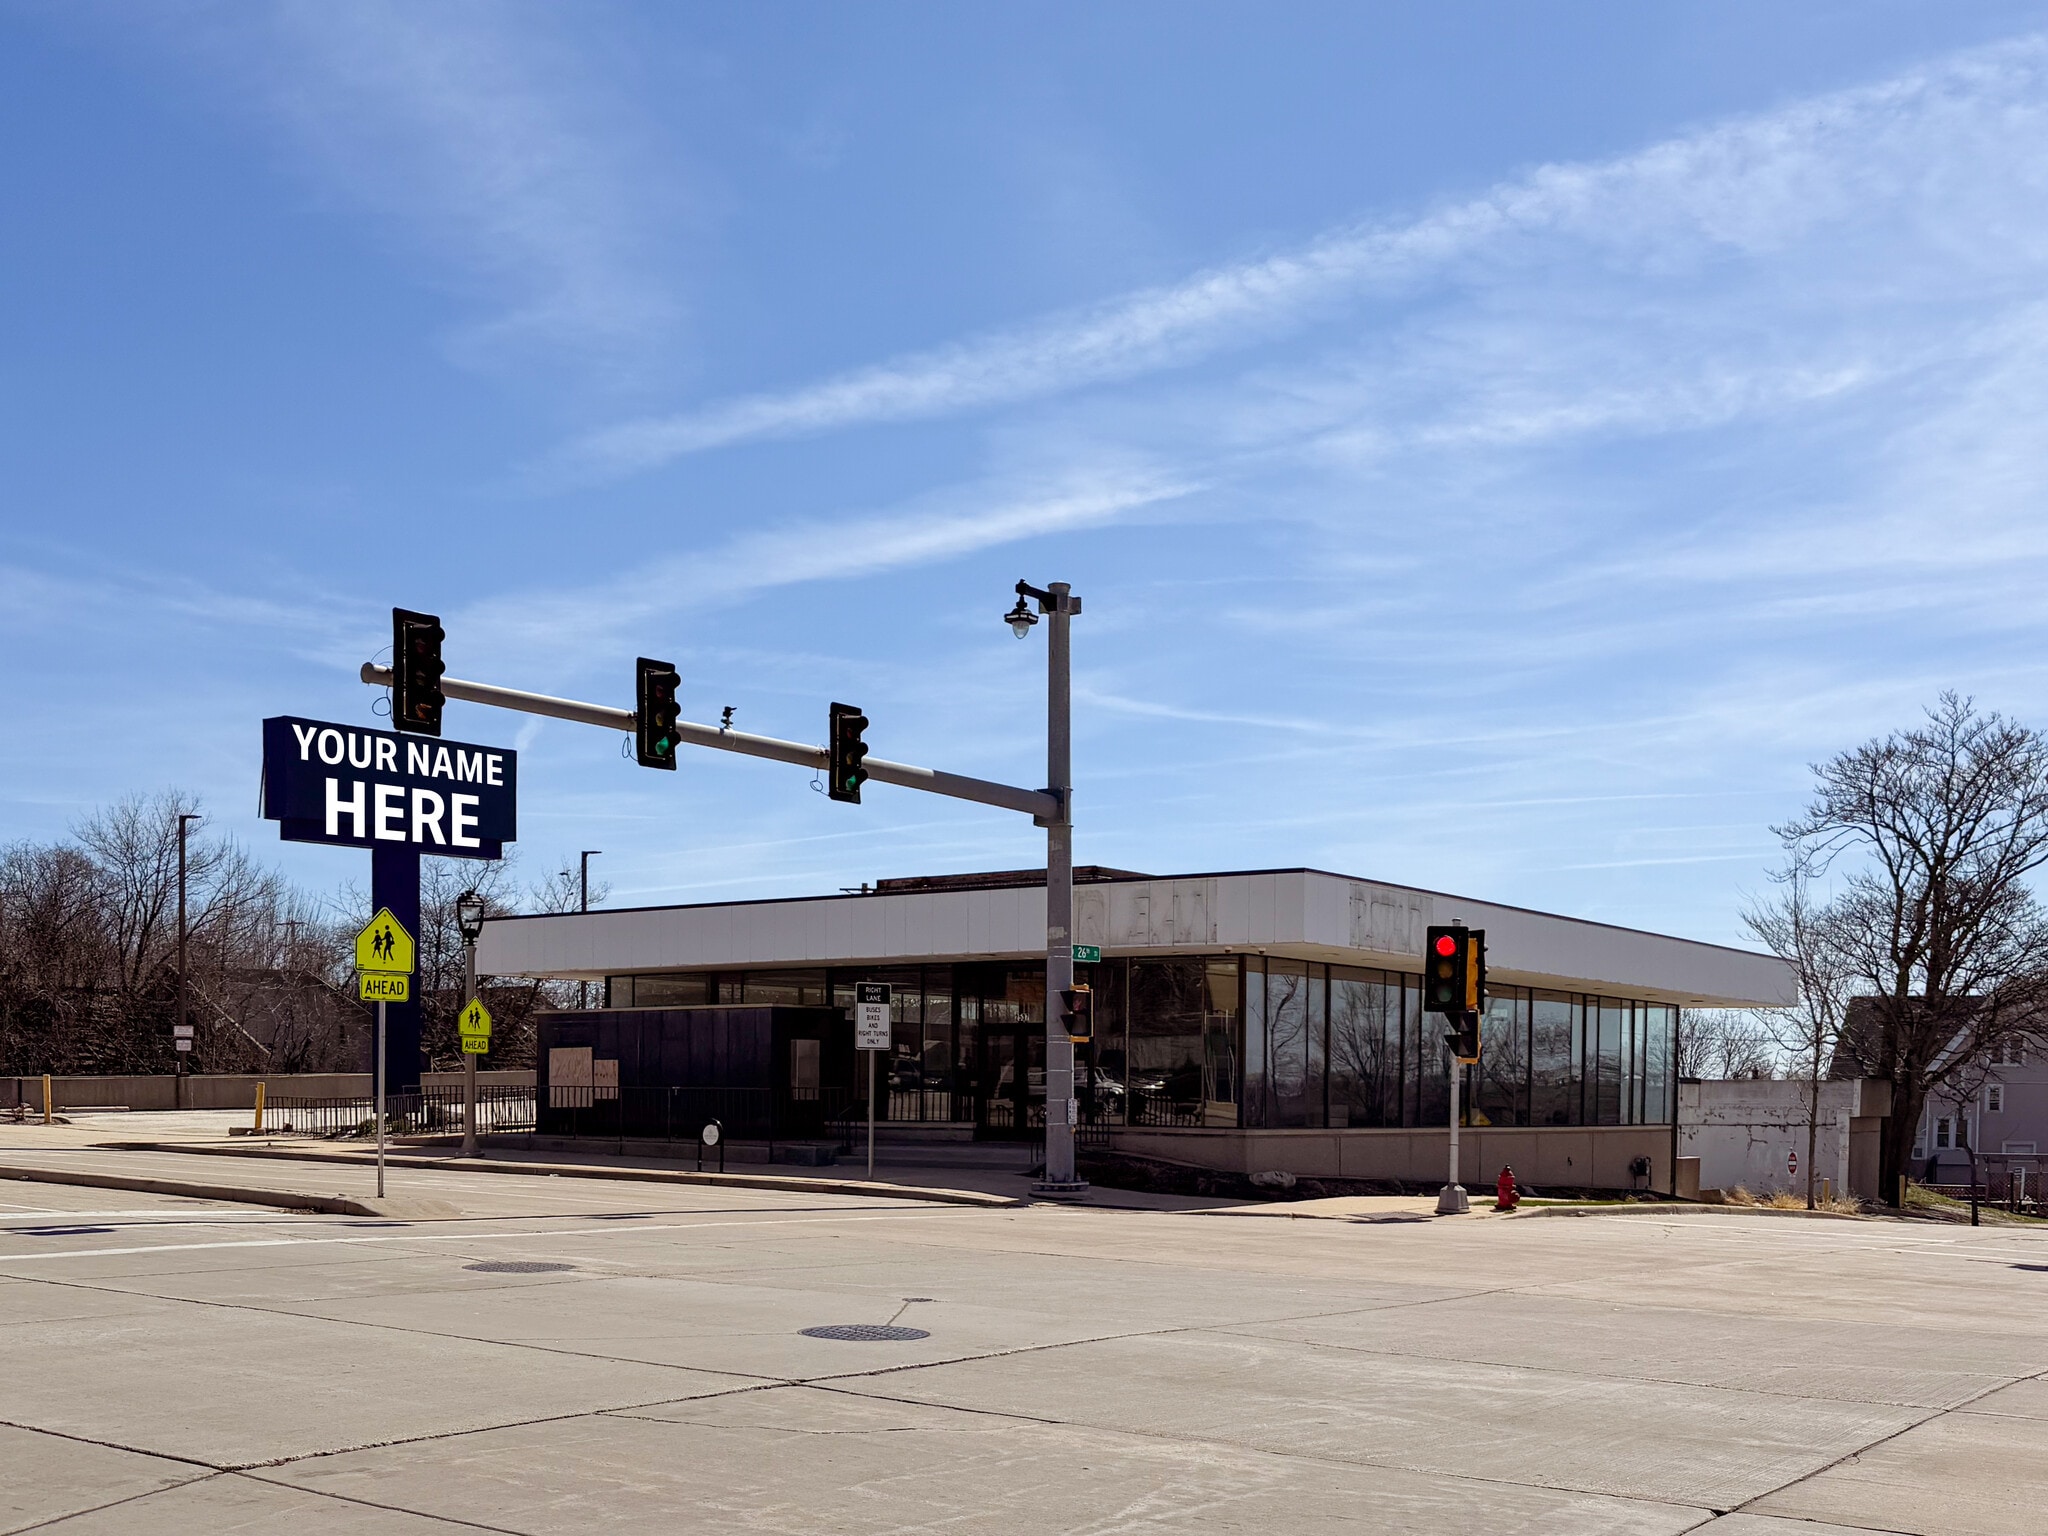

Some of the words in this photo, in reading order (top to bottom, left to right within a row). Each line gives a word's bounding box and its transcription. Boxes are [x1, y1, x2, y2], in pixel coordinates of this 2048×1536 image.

[291, 723, 398, 773] YOUR
[407, 741, 504, 787] NAME
[325, 777, 481, 848] HERE
[365, 980, 405, 995] AHEAD
[464, 1040, 487, 1050] AHEAD
